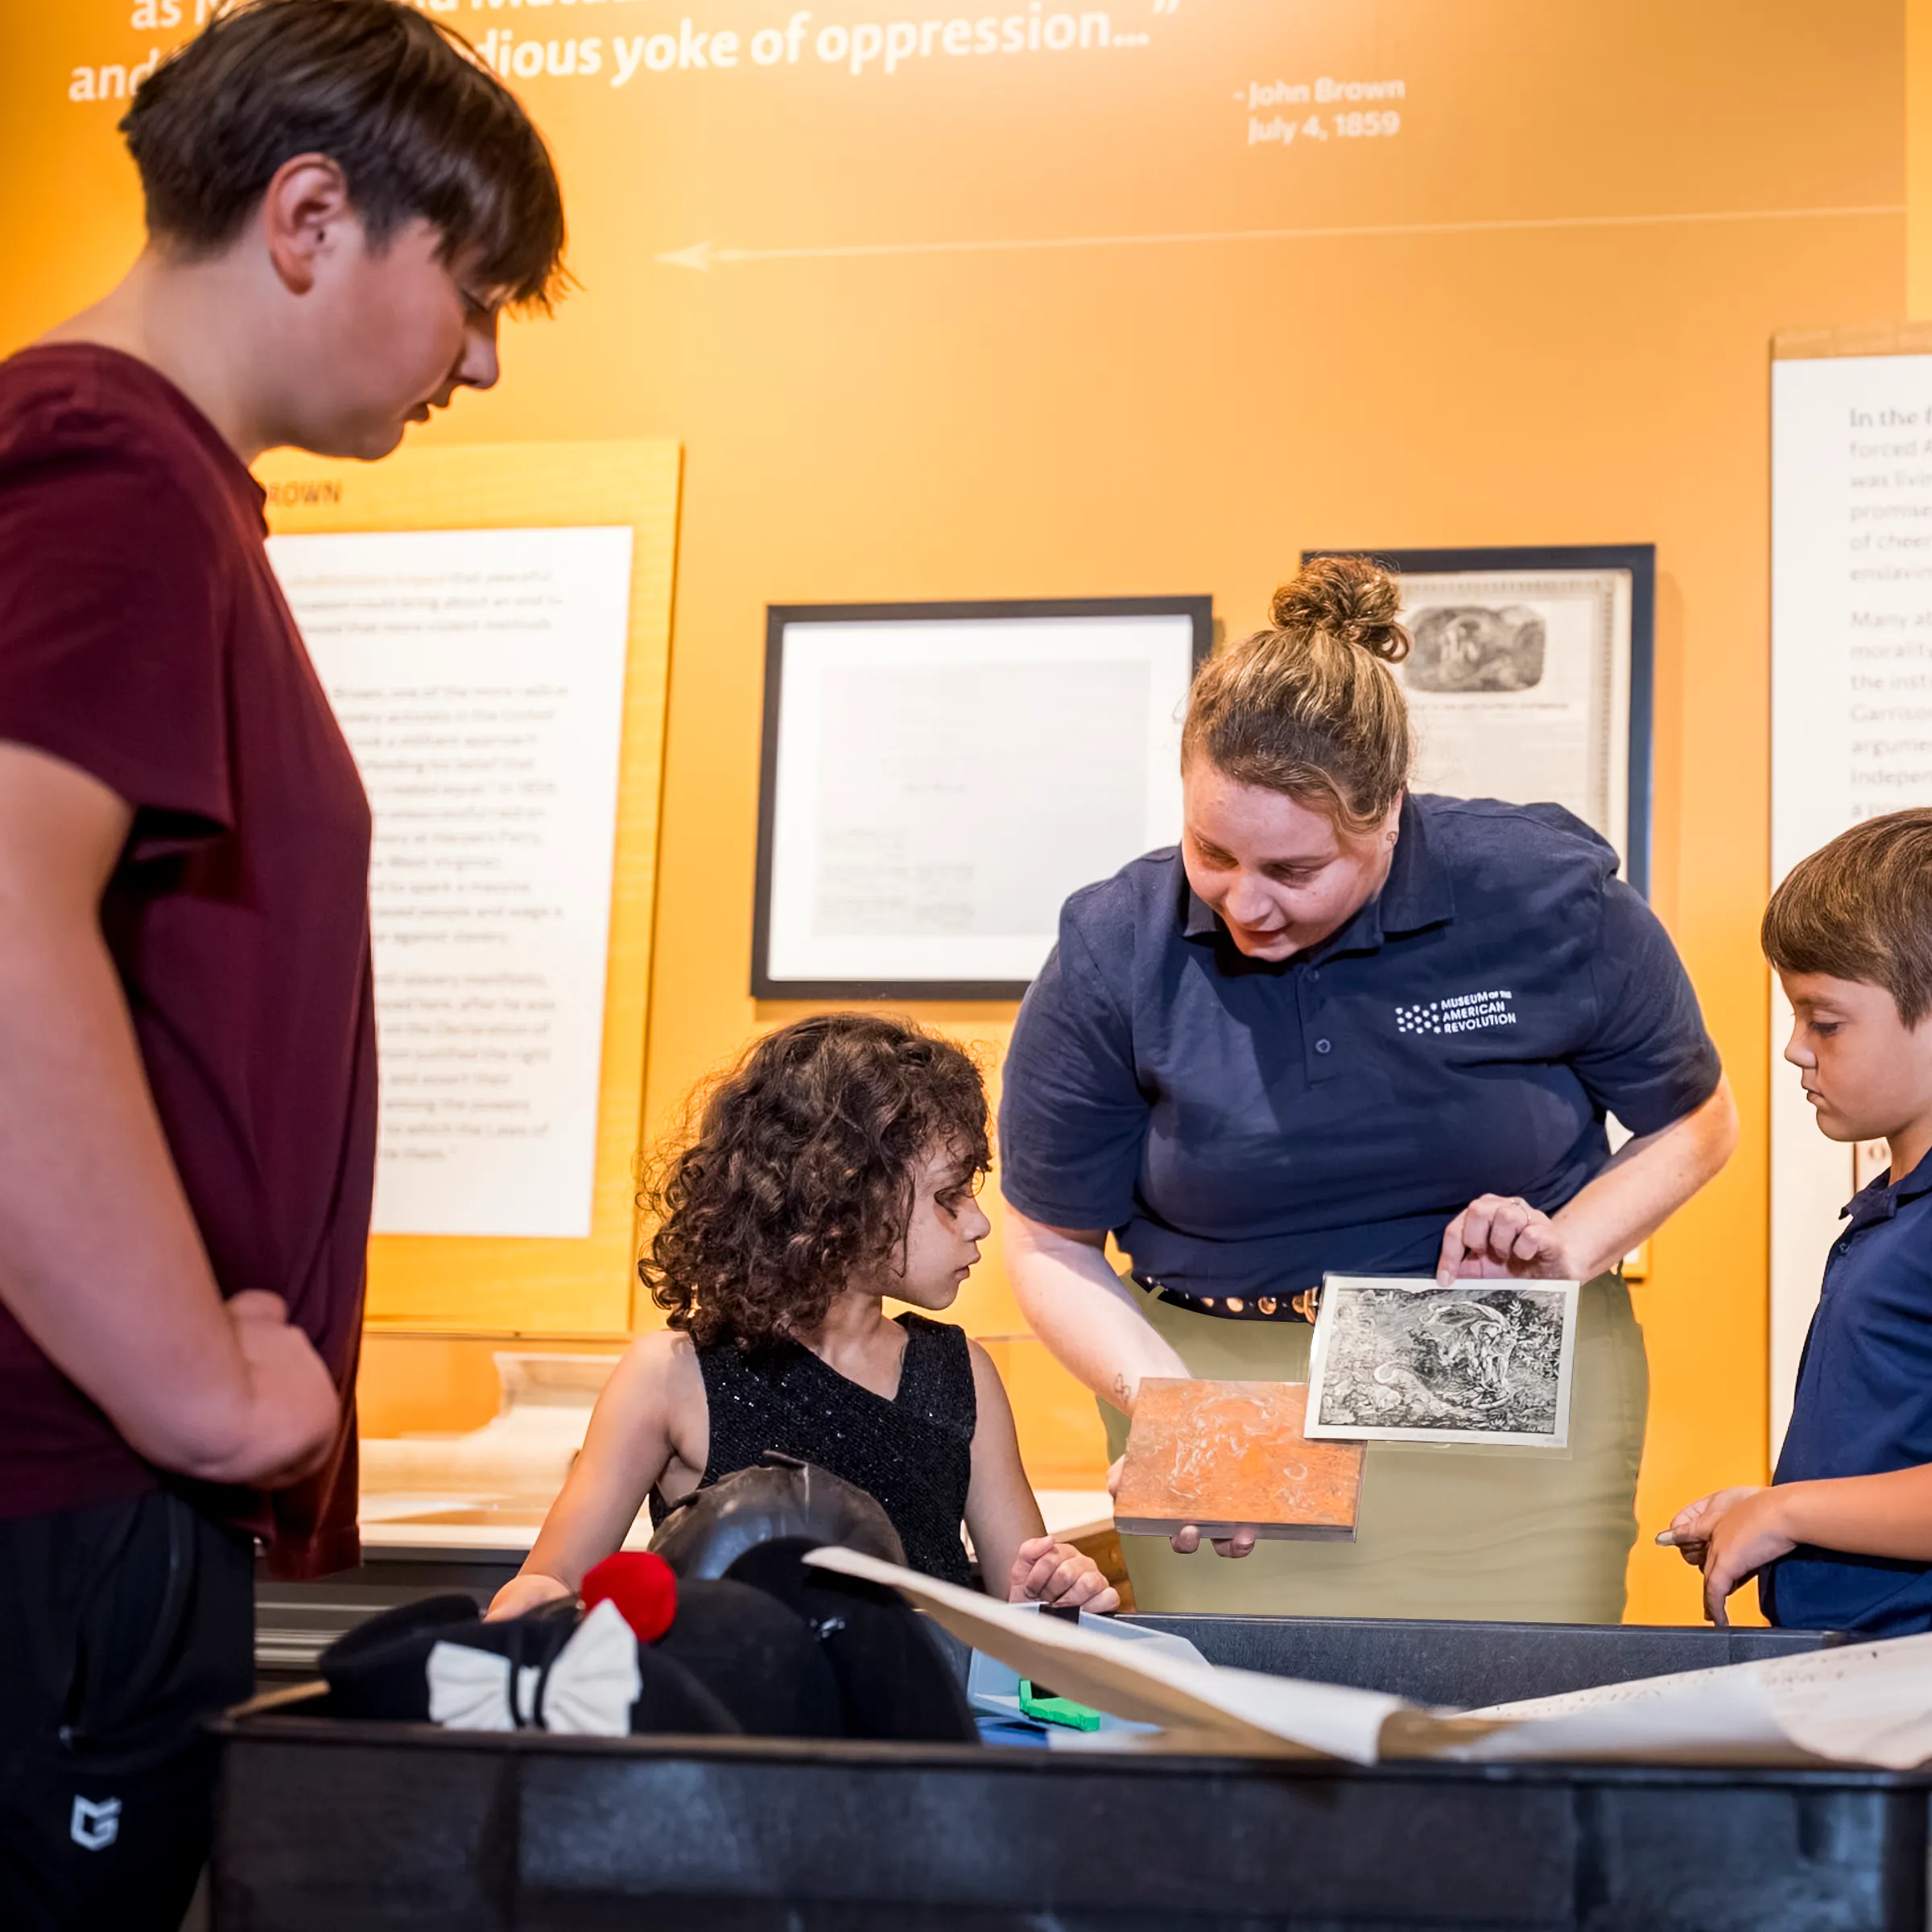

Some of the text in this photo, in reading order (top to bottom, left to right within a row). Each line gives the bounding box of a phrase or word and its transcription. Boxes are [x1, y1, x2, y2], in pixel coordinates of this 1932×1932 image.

[609, 17, 740, 88] yoke
[749, 10, 813, 66] of
[1248, 79, 1311, 111] John
[1315, 76, 1406, 105] Brown
[1248, 114, 1299, 147] July
[1332, 109, 1401, 138] 1859
[1441, 991, 1488, 1010] MUSEUM
[1443, 1001, 1505, 1023] AMERICAN
[1443, 1012, 1517, 1034] REVOLUTION
